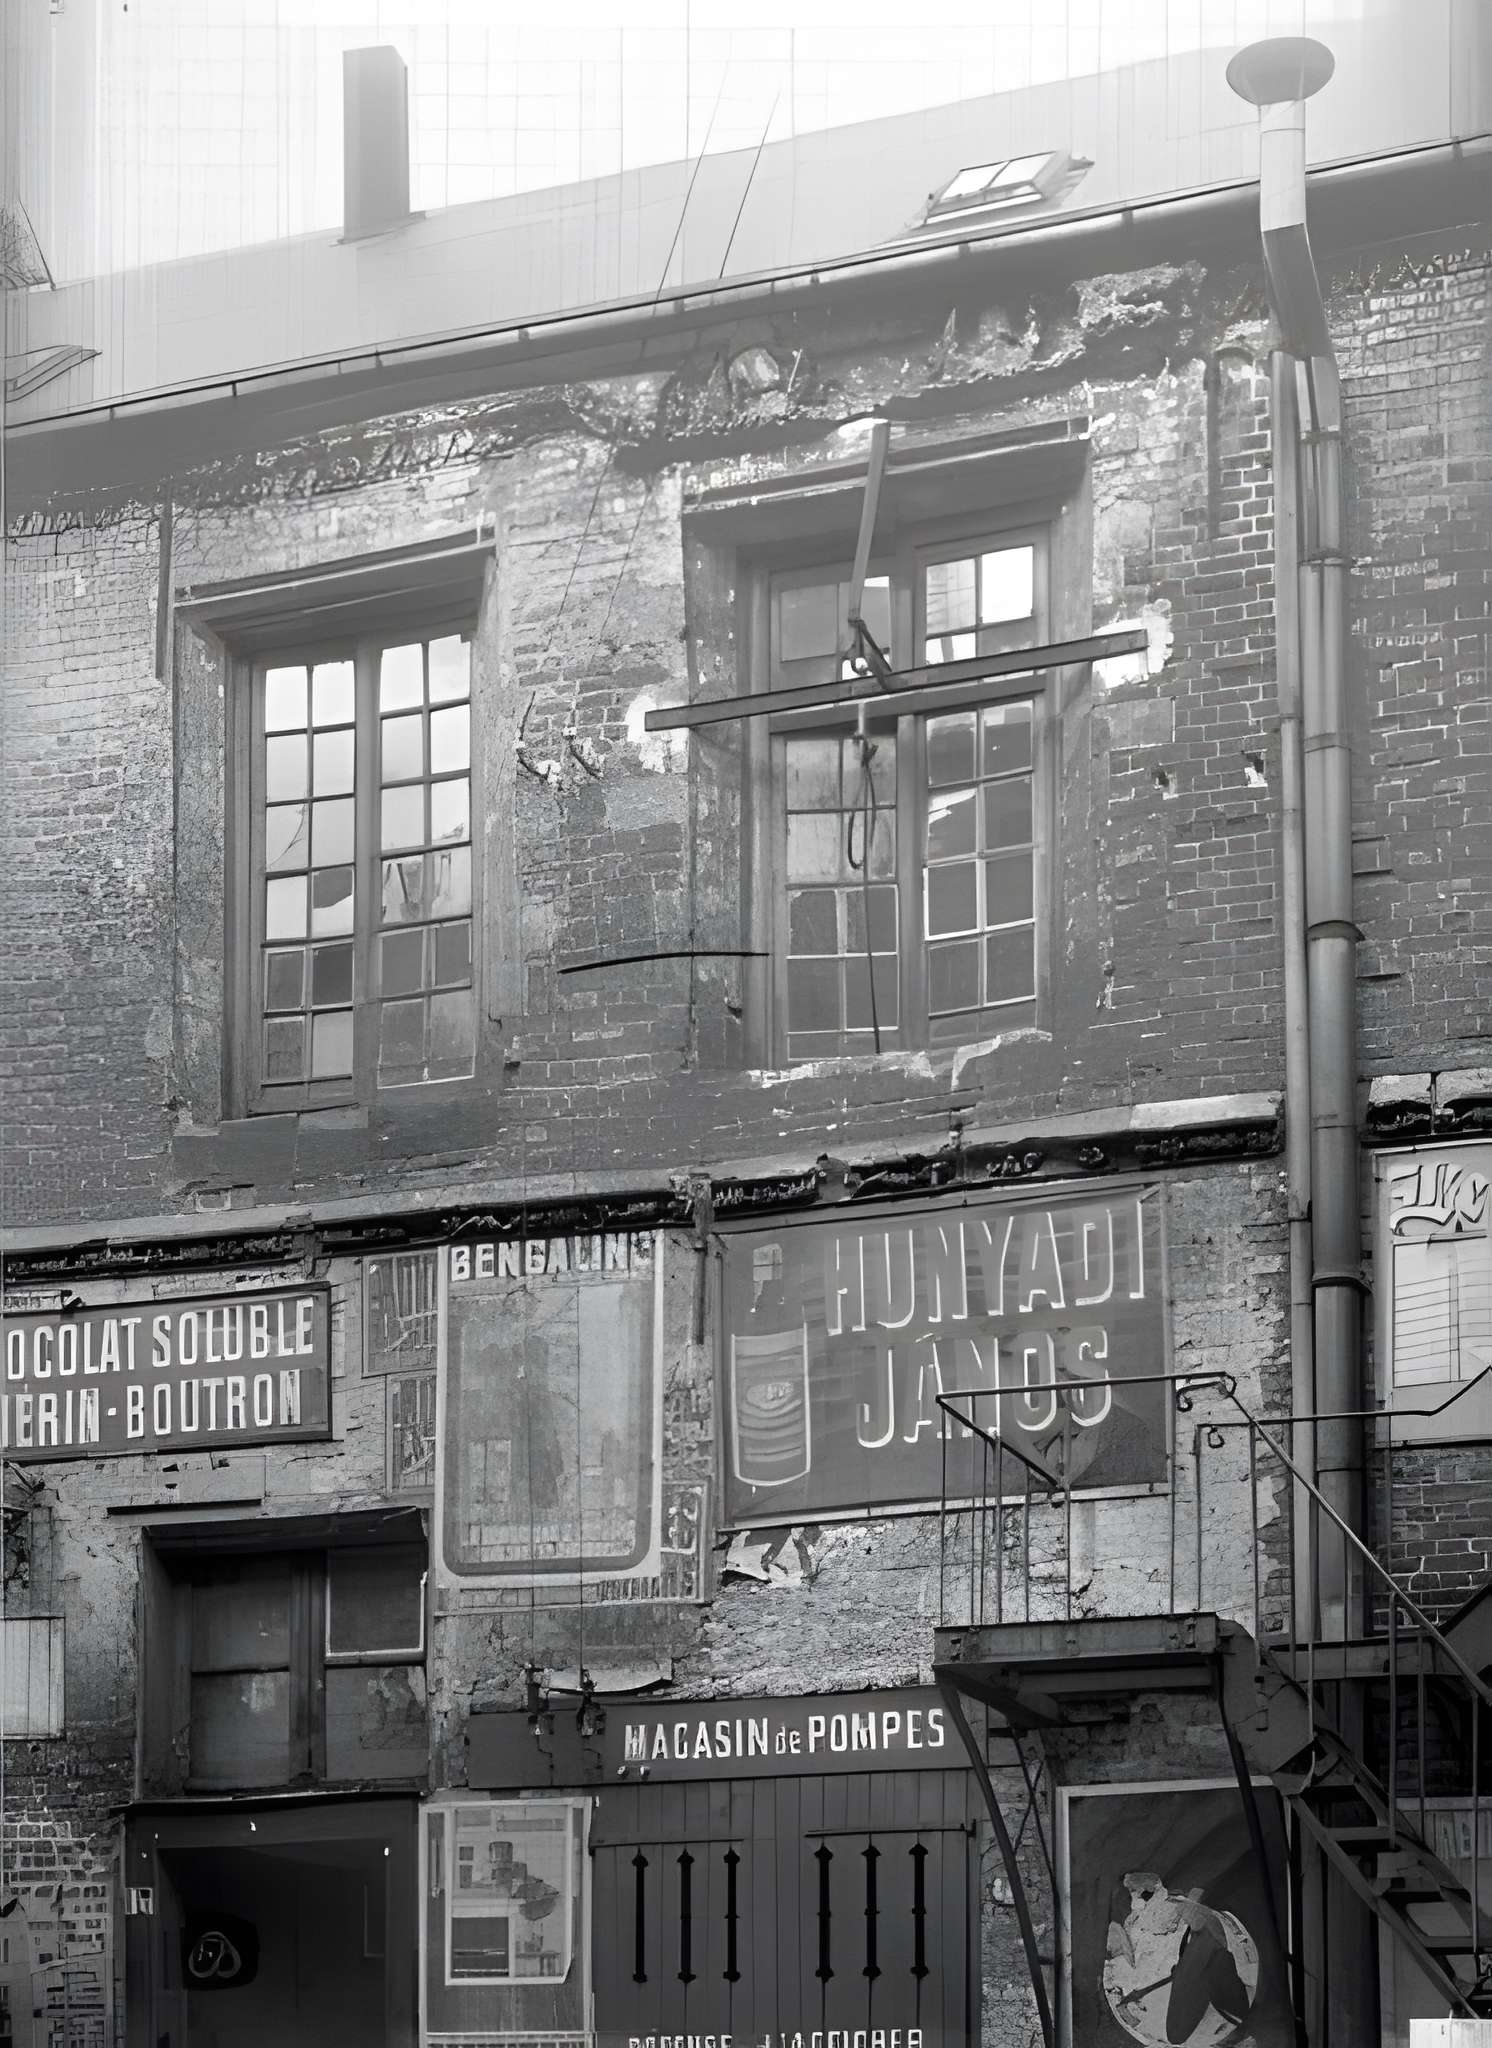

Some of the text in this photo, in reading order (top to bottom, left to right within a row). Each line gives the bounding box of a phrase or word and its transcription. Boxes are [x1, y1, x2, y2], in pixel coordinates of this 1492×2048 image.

[825, 1201, 1145, 1336] HUNYADI
[7, 1316, 142, 1380] OCOLAT
[152, 1299, 314, 1368] SOLUBLE
[624, 1708, 945, 1761] MAGASIN de POMPES
